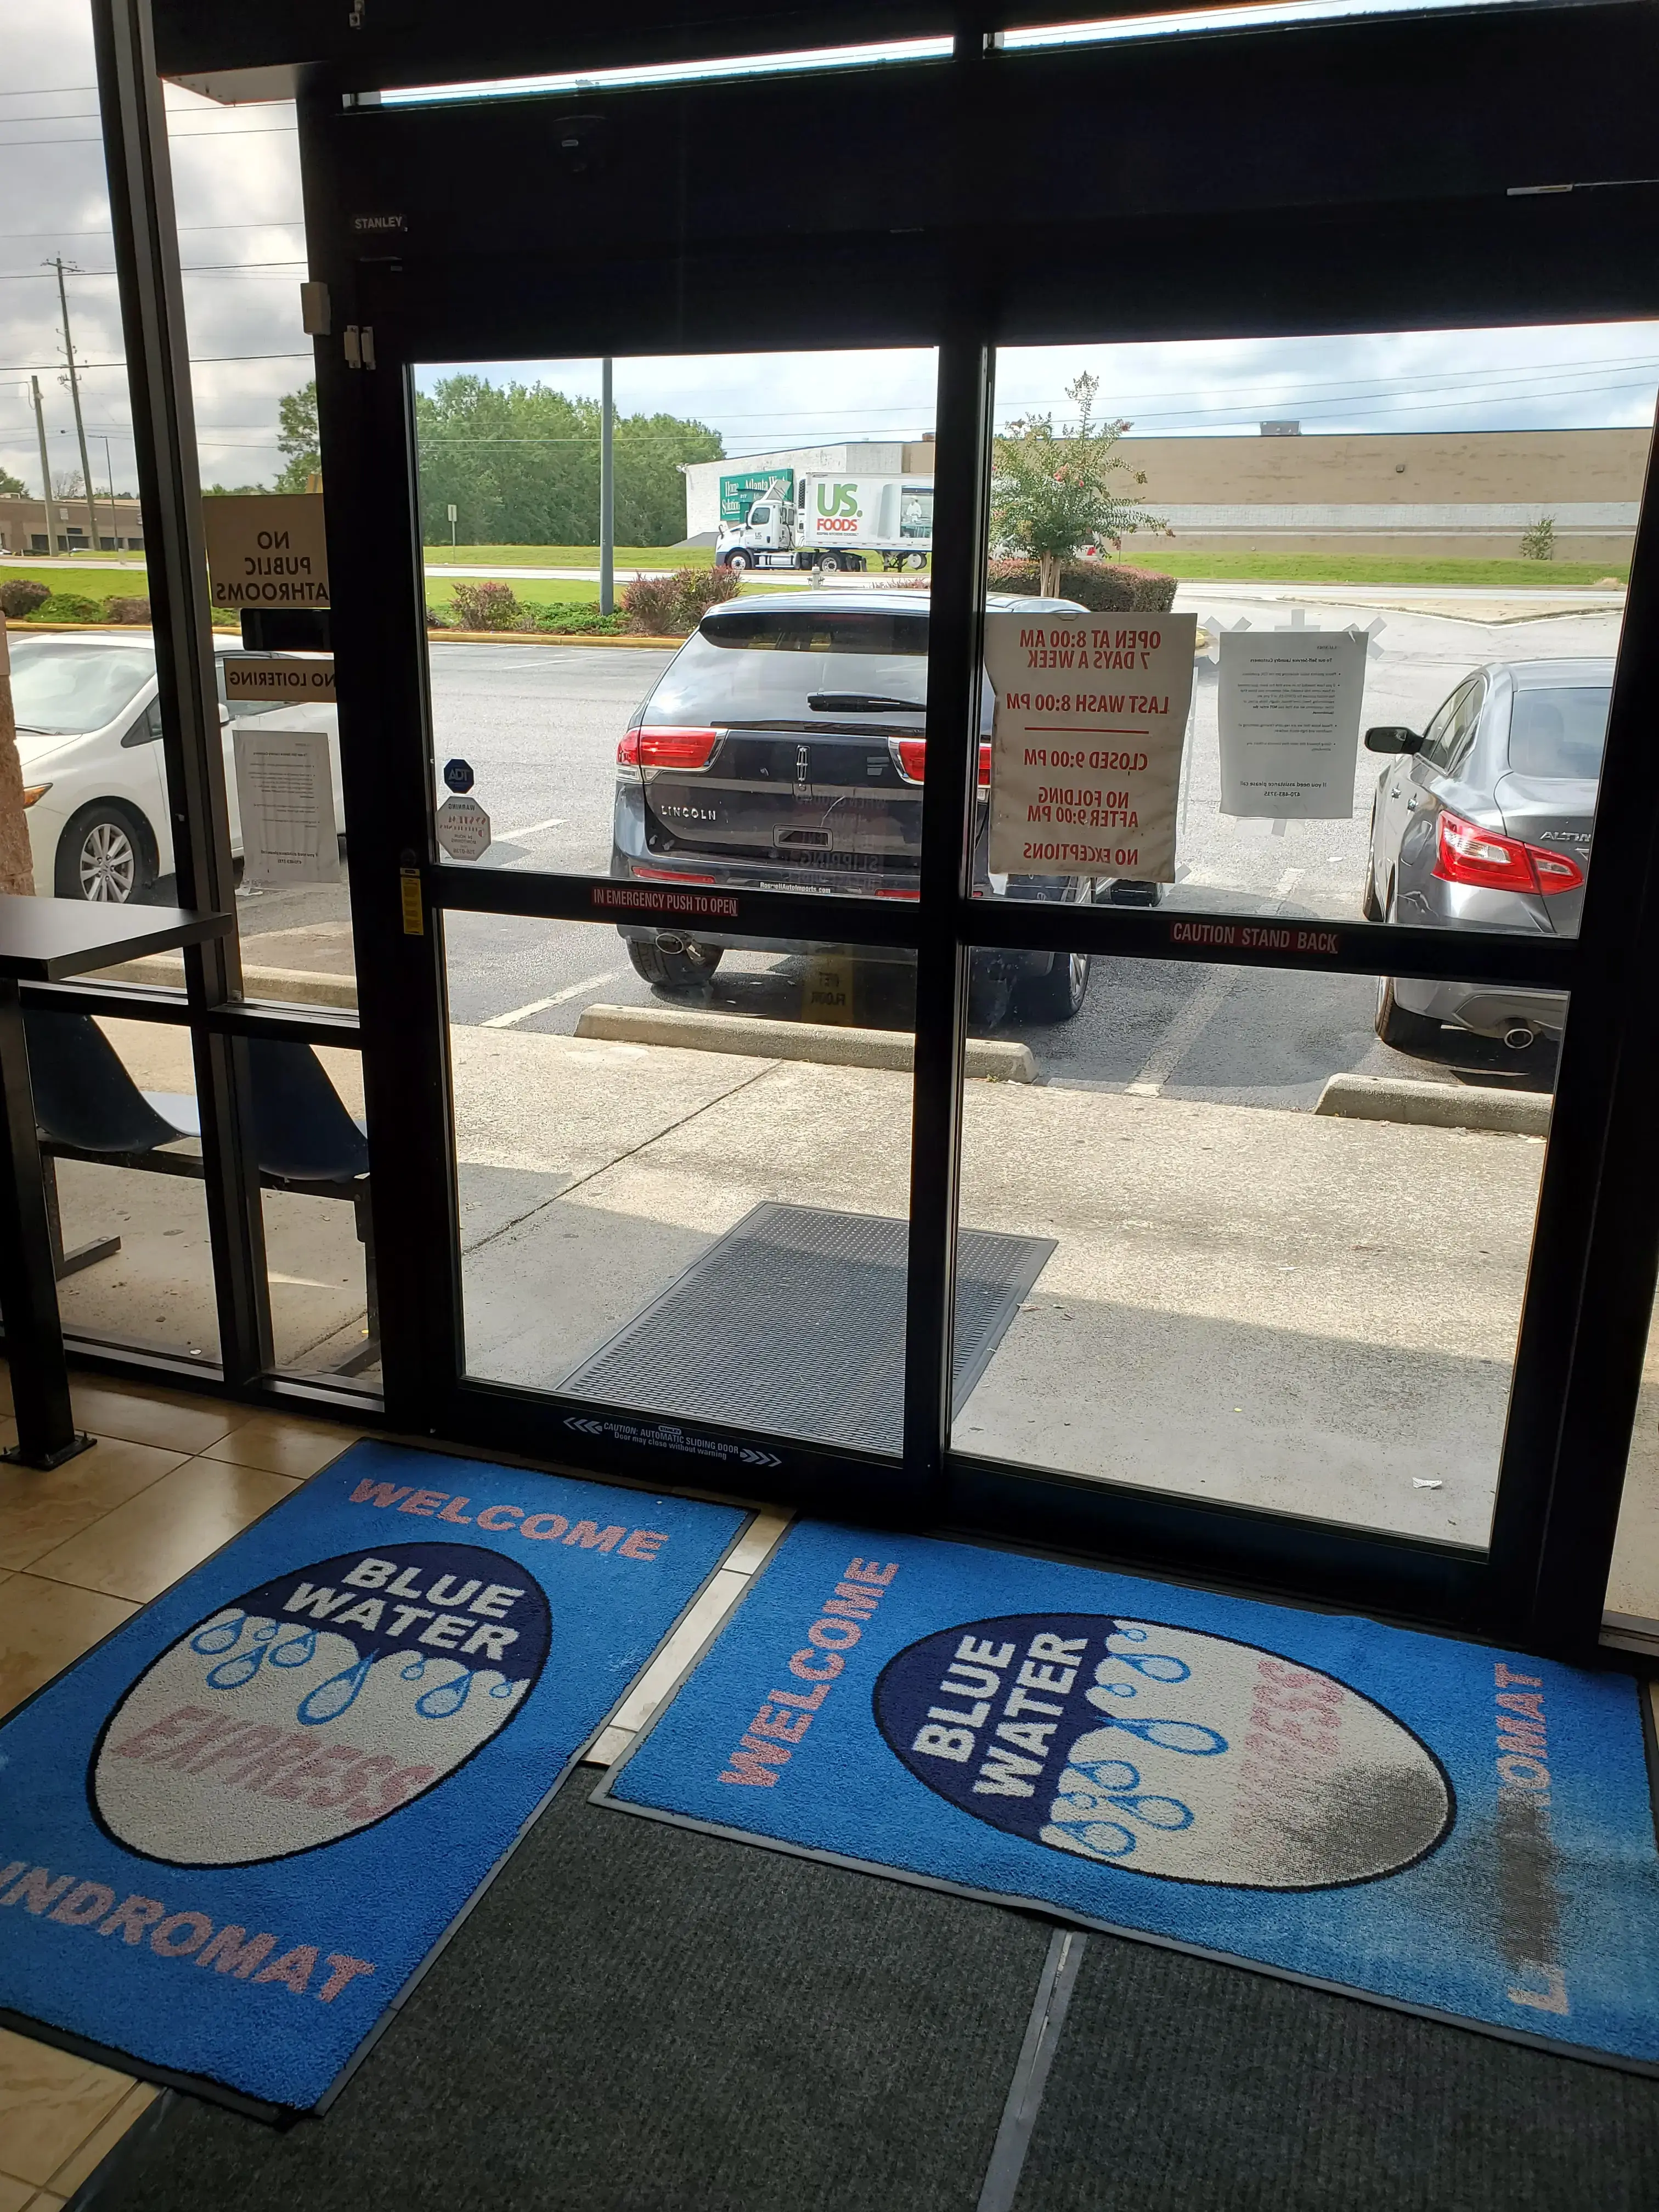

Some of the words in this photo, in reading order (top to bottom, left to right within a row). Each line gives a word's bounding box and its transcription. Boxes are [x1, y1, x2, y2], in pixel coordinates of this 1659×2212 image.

[356, 216, 403, 230] STANLEY
[725, 481, 739, 496] Home
[744, 478, 768, 491] Atlanta
[817, 518, 858, 532] FOODS
[448, 768, 471, 781] ADT
[661, 805, 716, 821] LINCOLN
[1539, 831, 1592, 842] ALTIM
[594, 888, 604, 904] IN
[606, 889, 665, 909] EMERGENCY
[667, 894, 693, 911] PUSH
[695, 896, 708, 912] TO
[710, 898, 737, 915] OPEN
[760, 882, 831, 894] RoswellAutoImportscom
[1173, 923, 1234, 944] CAUTION
[1242, 927, 1290, 948] STAND
[1297, 932, 1338, 952] BACK
[604, 1422, 639, 1435] CAUTION:
[640, 1428, 684, 1444] AUTOMATIC
[686, 1437, 716, 1450] SLIDING
[718, 1443, 738, 1454] DOOR
[614, 1431, 630, 1441] Door
[632, 1436, 647, 1446] may
[648, 1437, 667, 1448] close
[669, 1442, 696, 1454] without
[697, 1448, 727, 1460] warning
[348, 1477, 669, 1561] WELCOME
[341, 1557, 527, 1620] BLUE
[282, 1582, 521, 1662] WATER
[718, 1556, 900, 1788] WELCOME
[912, 1635, 1016, 1763] BLUE
[973, 1633, 1088, 1798] WATER
[0, 1861, 376, 2003] NDROMAT
